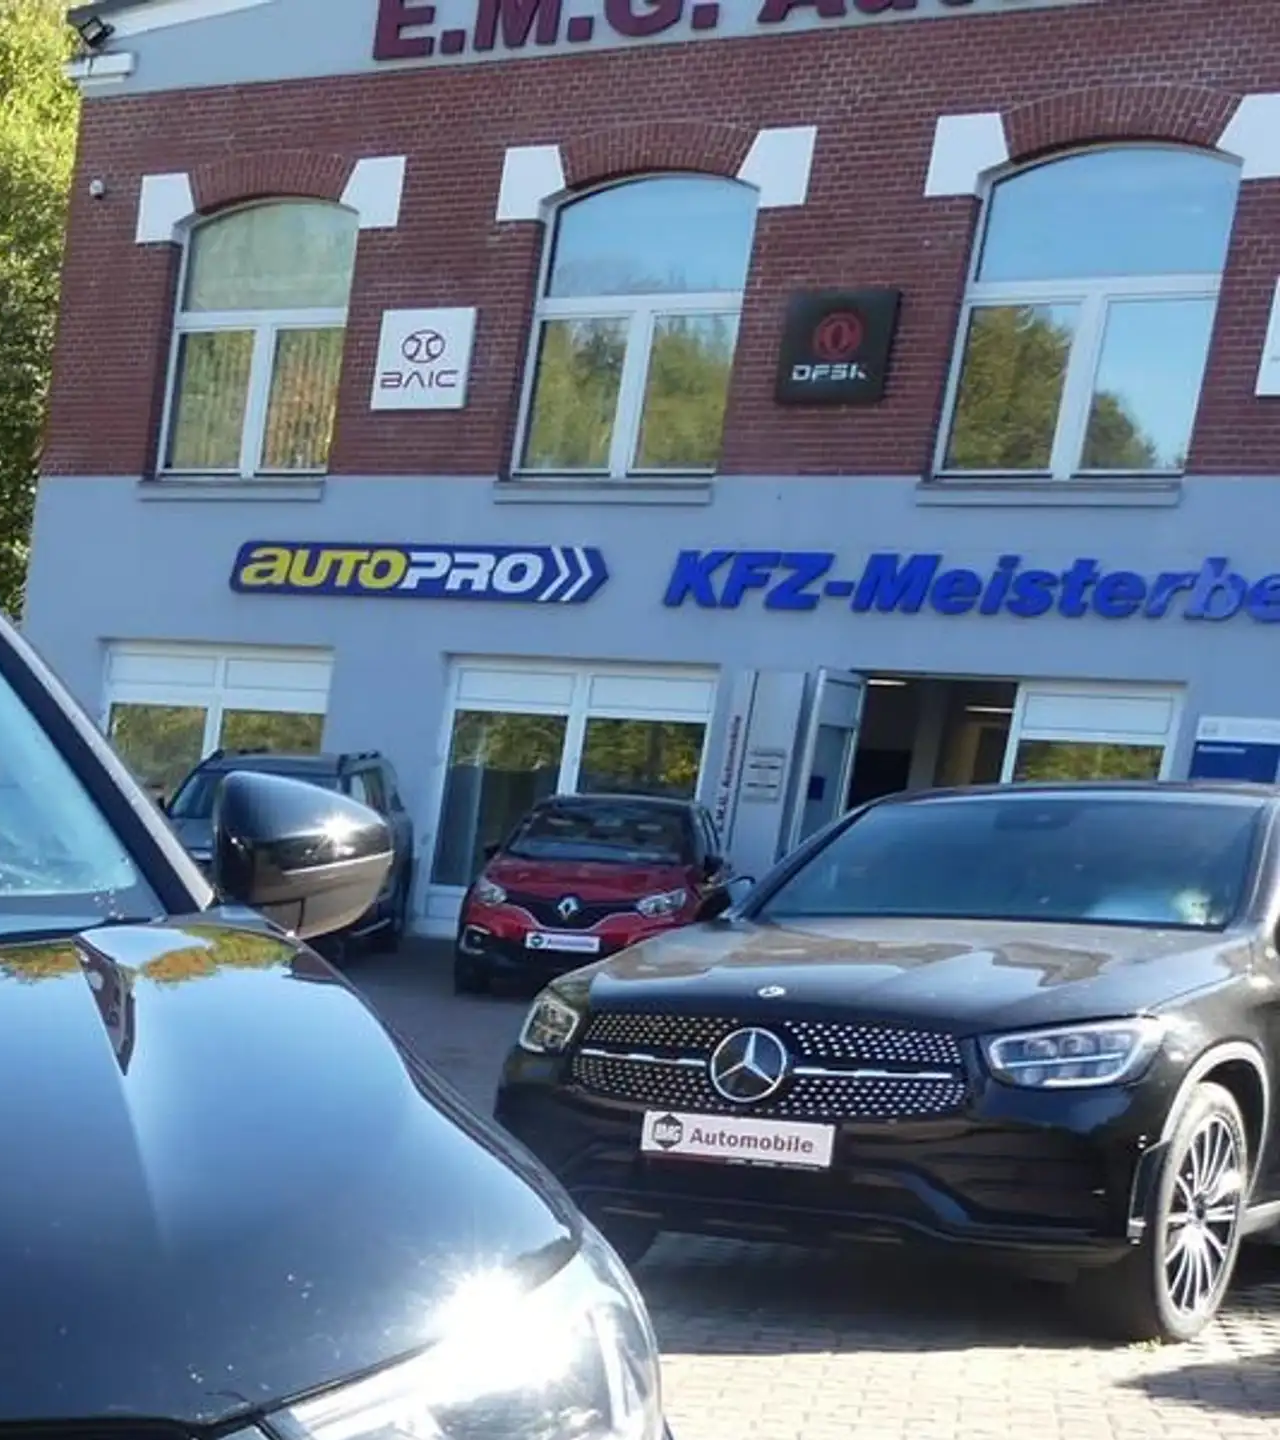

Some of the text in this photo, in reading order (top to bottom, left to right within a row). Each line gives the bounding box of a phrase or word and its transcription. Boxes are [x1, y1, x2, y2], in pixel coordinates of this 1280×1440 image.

[380, 370, 458, 389] BAIC
[792, 364, 867, 381] DFSK
[690, 1127, 814, 1154] Automobile
